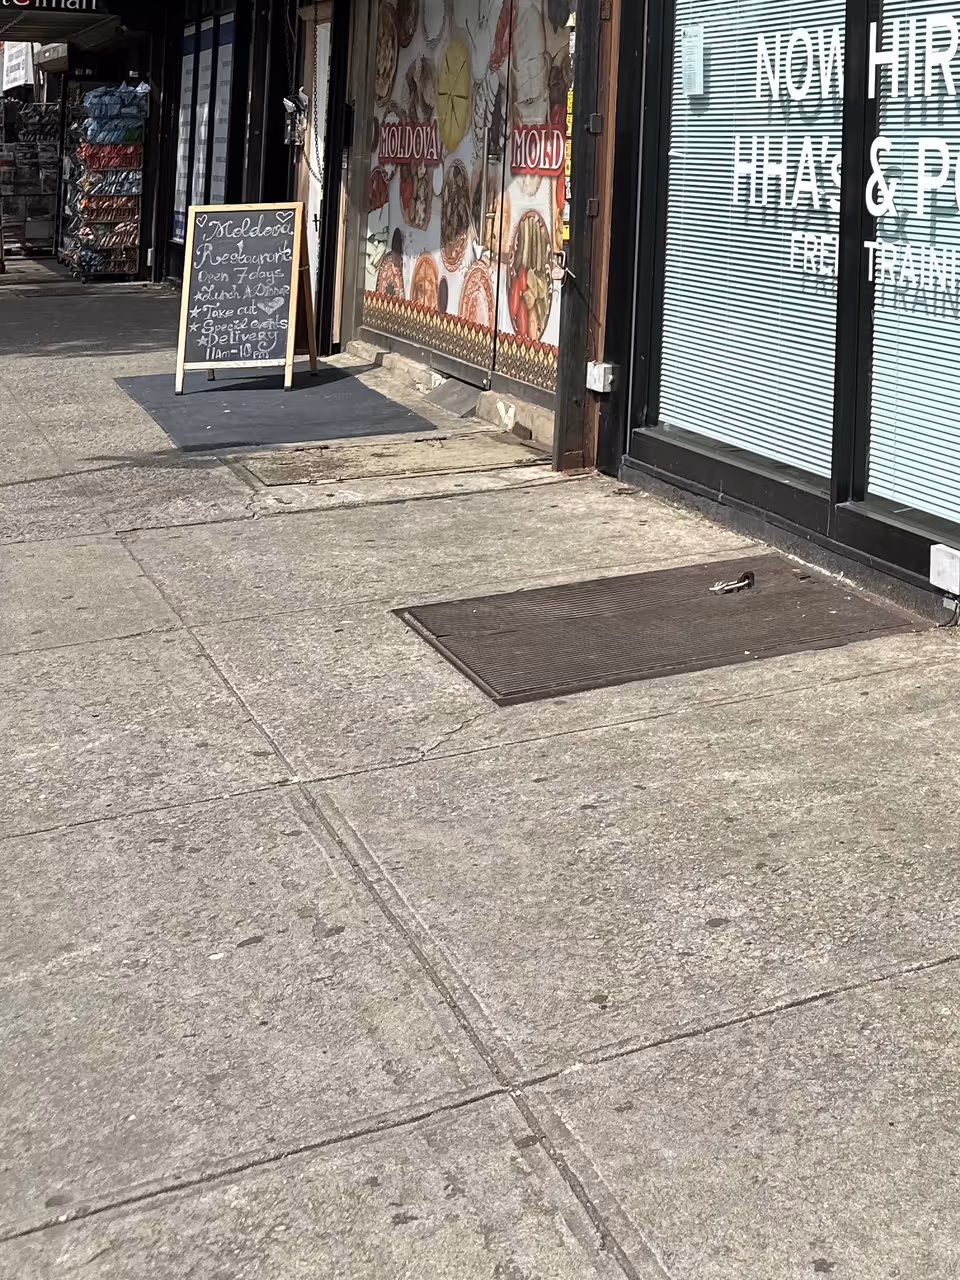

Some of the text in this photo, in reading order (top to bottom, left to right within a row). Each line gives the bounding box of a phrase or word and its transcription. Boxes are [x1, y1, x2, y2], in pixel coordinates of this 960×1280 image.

[755, 27, 846, 101] NOW
[380, 125, 565, 169] MOLDOVA MOLD
[864, 136, 903, 218] &
[203, 214, 294, 241] Moldova
[233, 267, 248, 284] 7
[248, 266, 285, 286] days
[201, 314, 289, 335] Special events
[203, 302, 234, 320] Take
